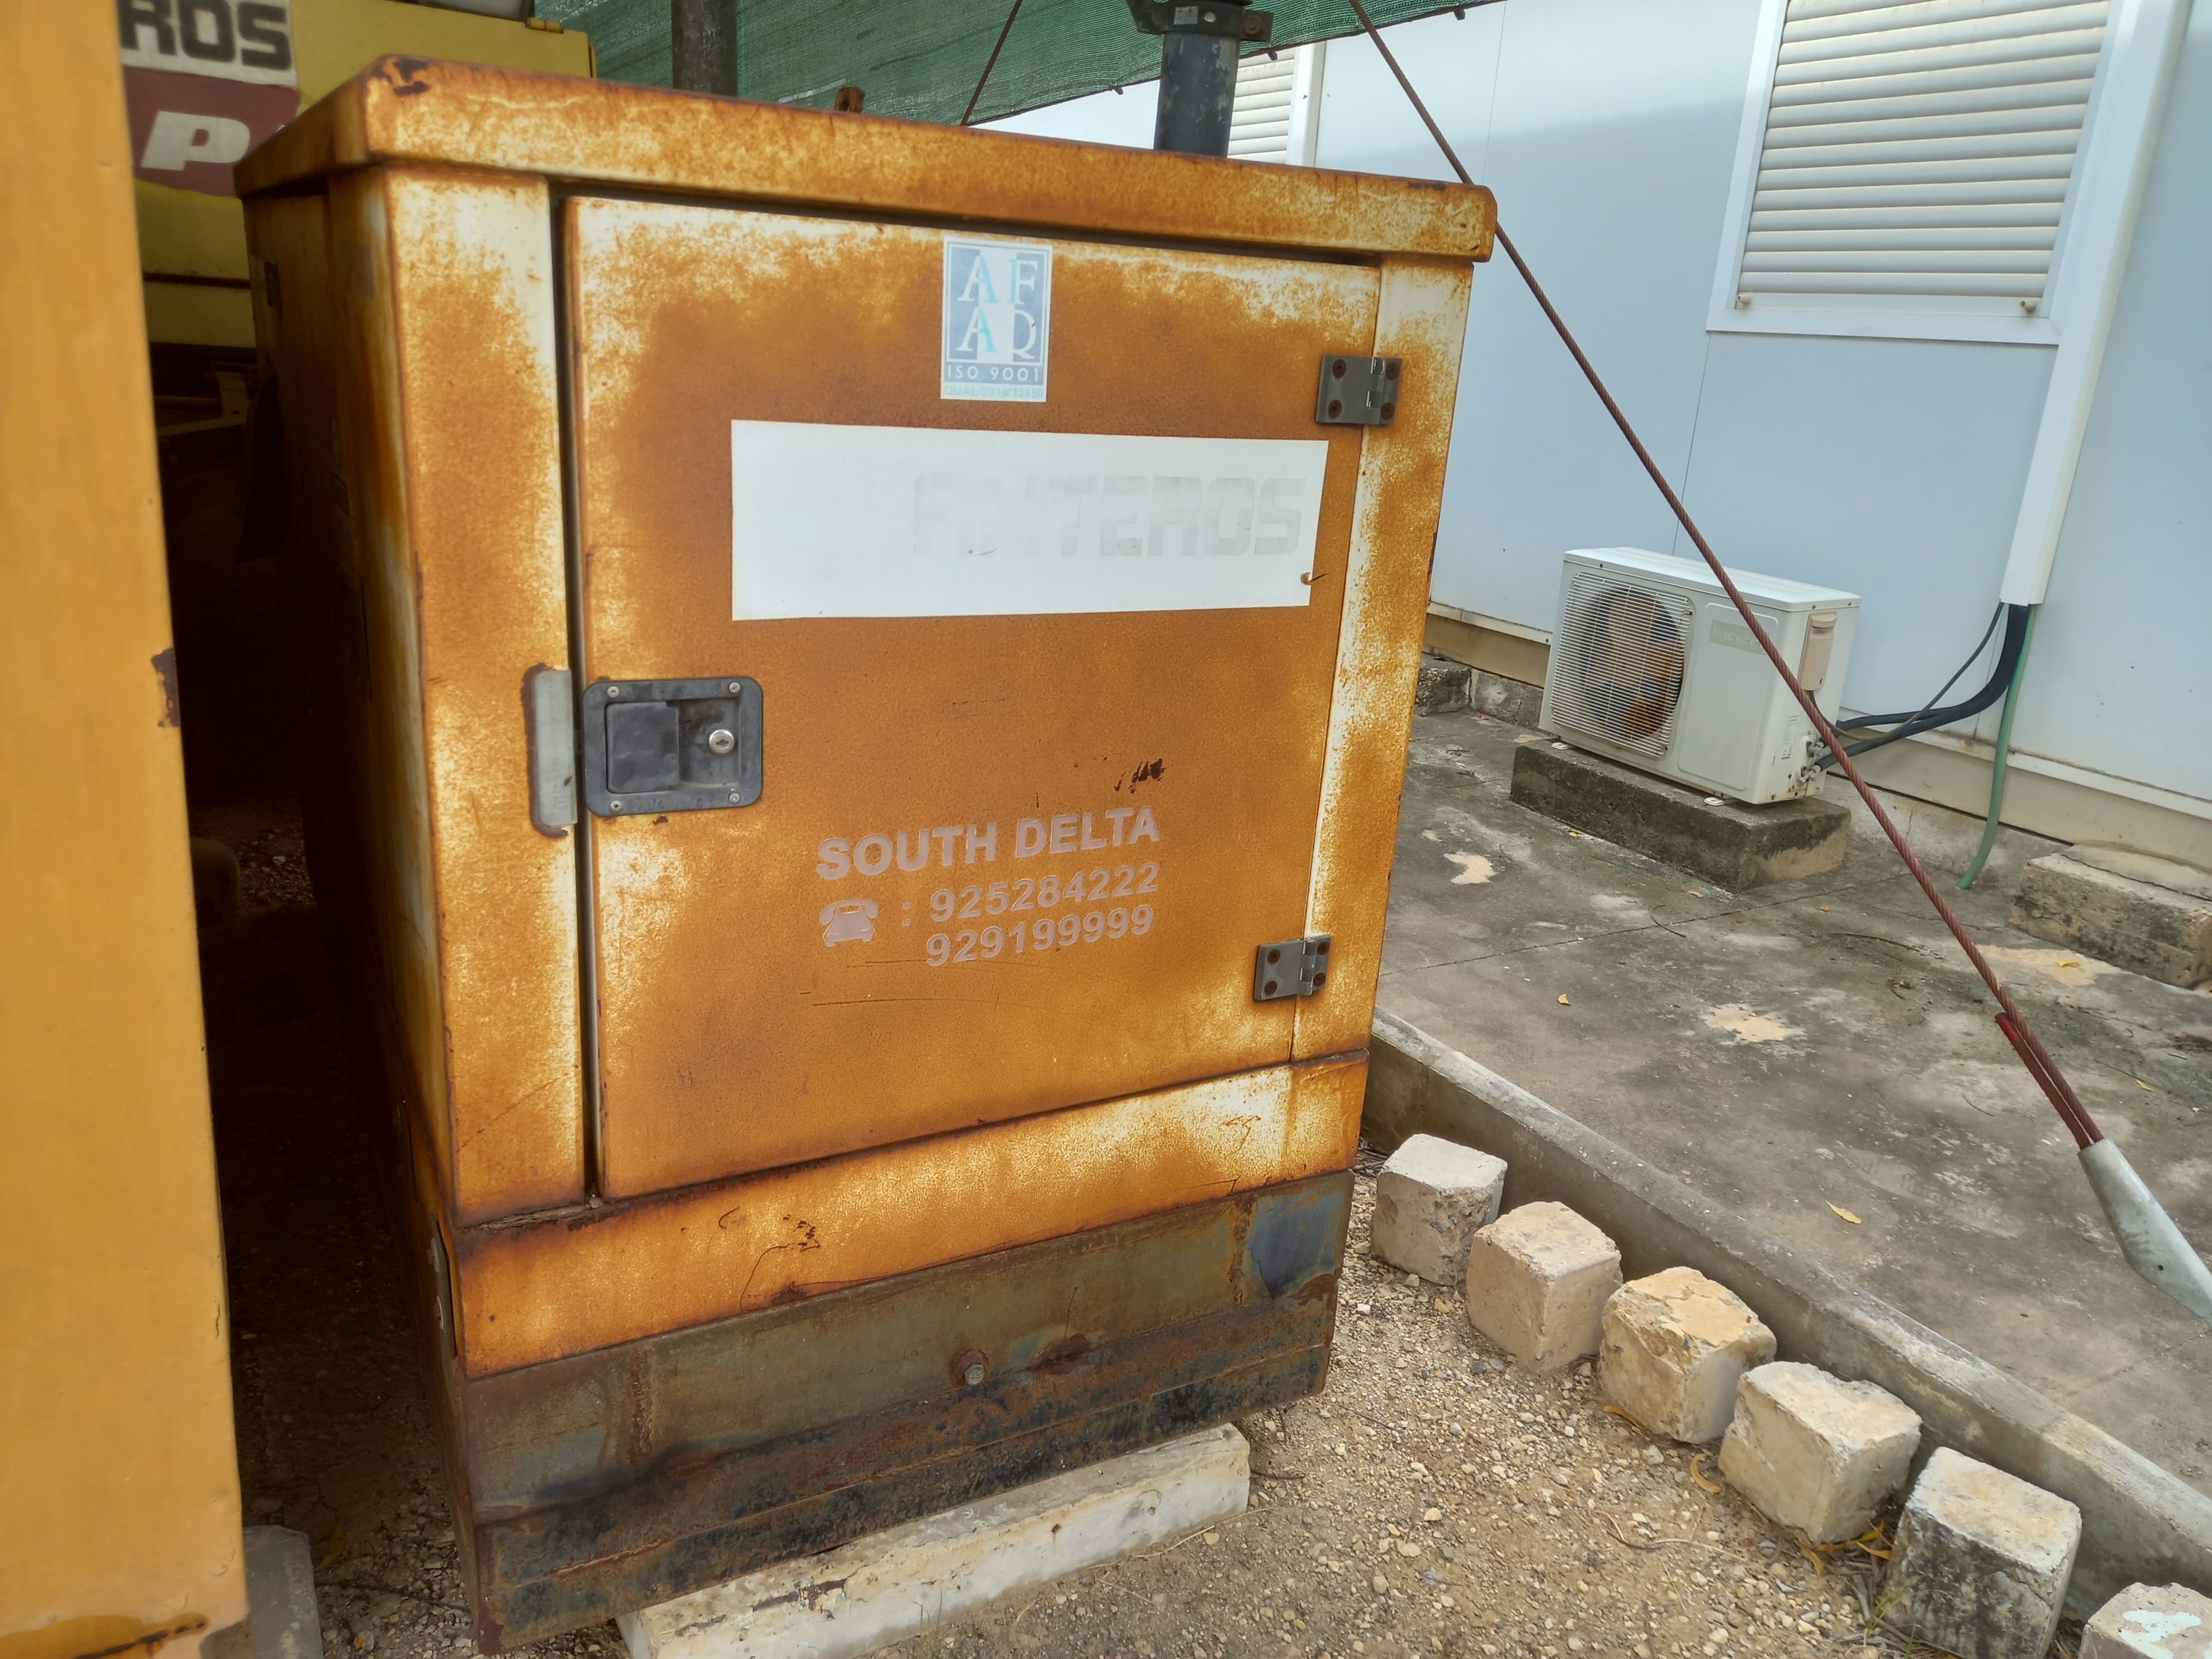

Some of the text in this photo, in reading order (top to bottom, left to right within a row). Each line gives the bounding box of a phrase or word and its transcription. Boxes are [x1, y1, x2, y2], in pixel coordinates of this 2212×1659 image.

[141, 110, 285, 171] P
[947, 364, 1039, 382] ISO 9001
[816, 806, 1160, 880] SOUTH DELTA
[930, 862, 1160, 922] 925284222
[926, 904, 1154, 967] 929199999
